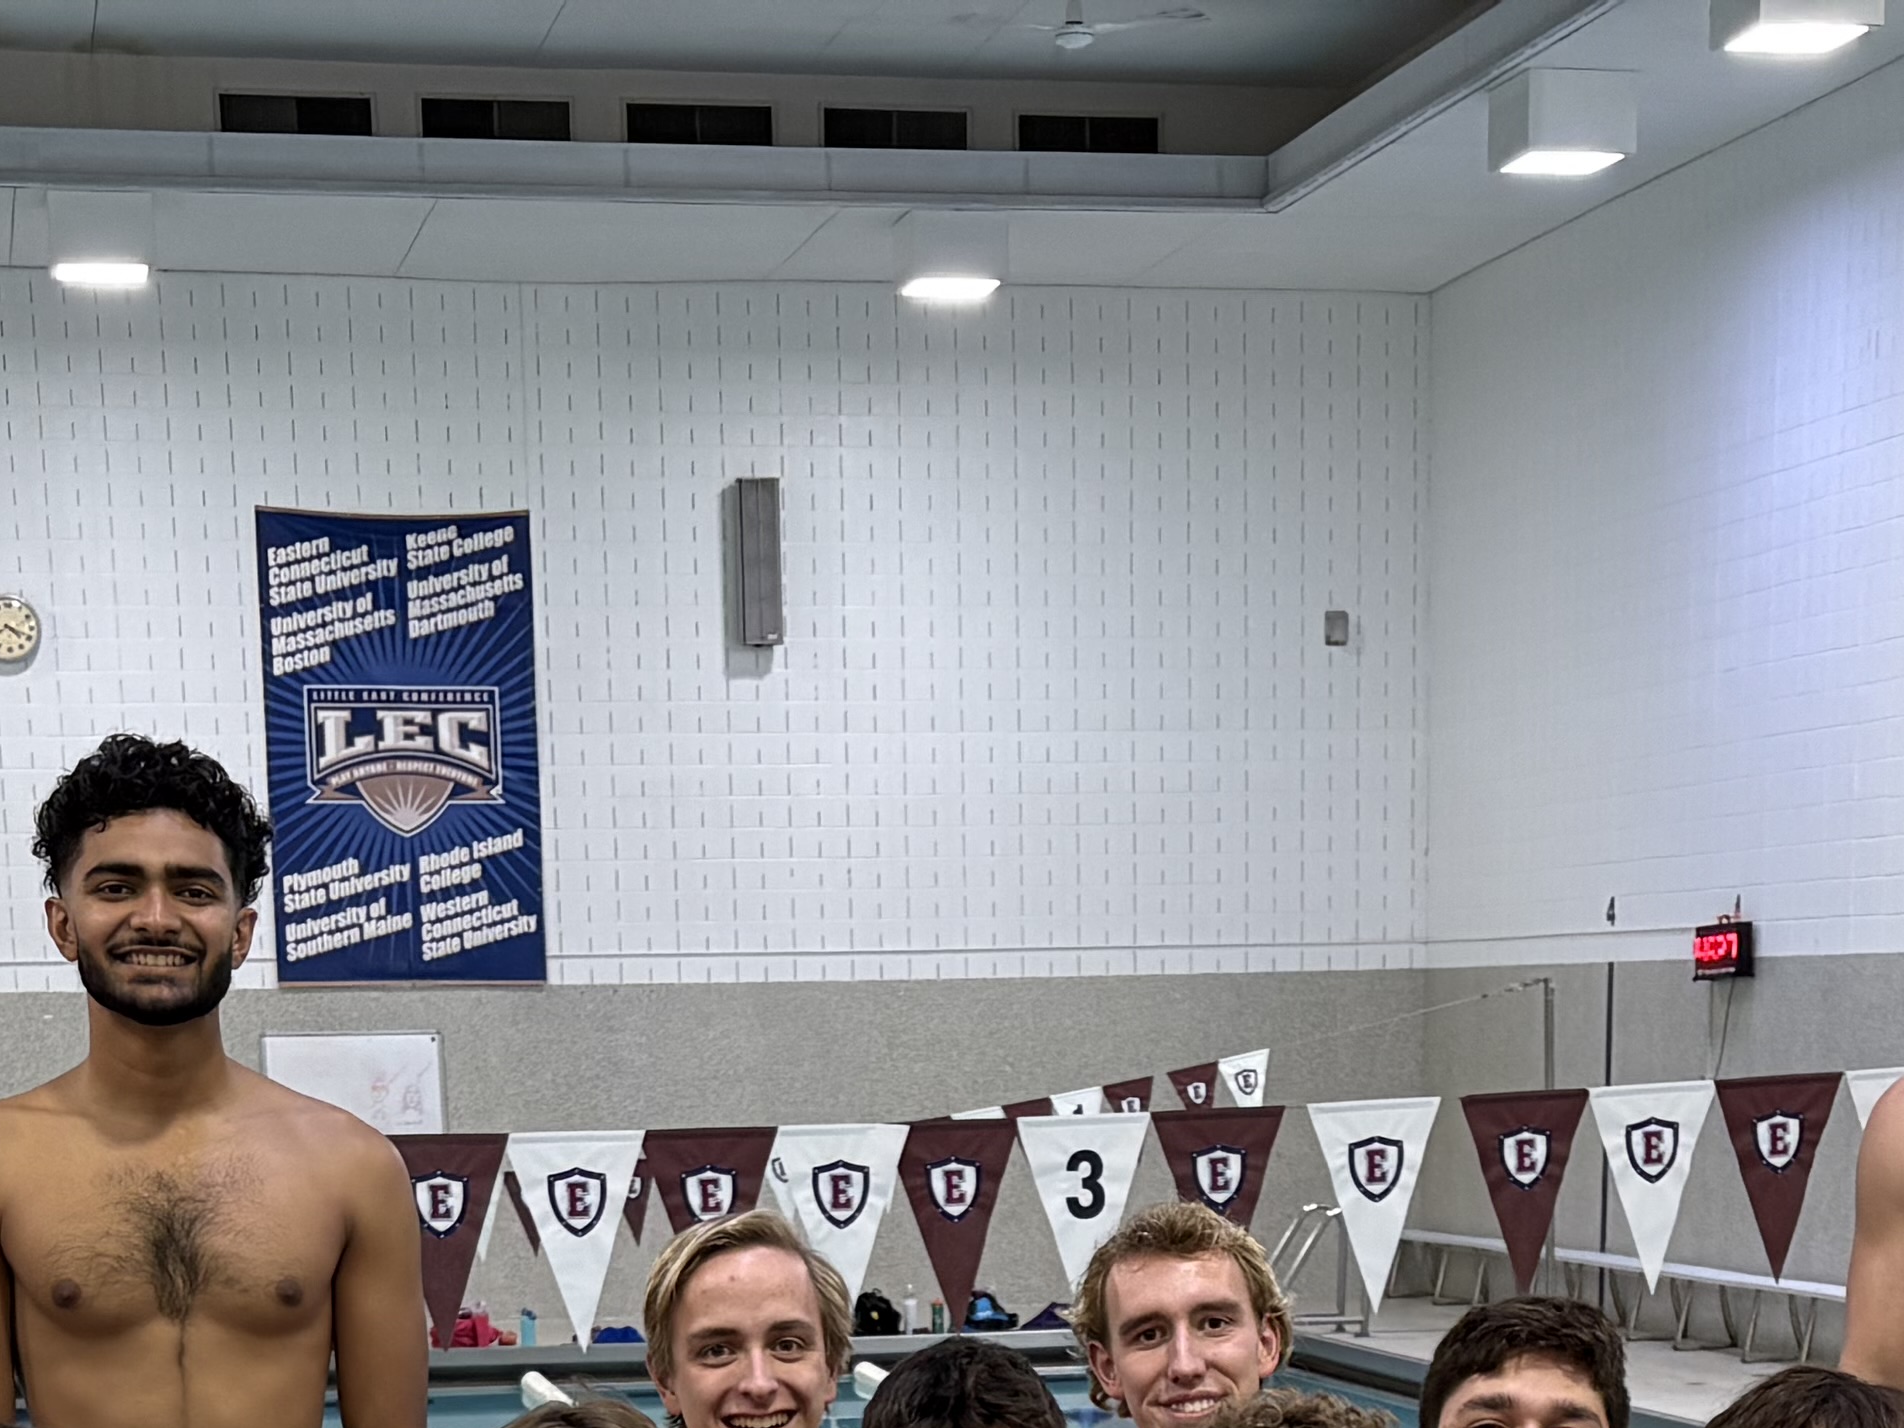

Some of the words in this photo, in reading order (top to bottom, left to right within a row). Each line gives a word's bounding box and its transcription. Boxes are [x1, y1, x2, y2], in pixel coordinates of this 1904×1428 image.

[268, 536, 330, 566] Eastern
[406, 525, 458, 550] Keene
[407, 544, 450, 570] State
[452, 525, 514, 558] College
[269, 544, 369, 585] Connecticut
[270, 578, 312, 607] State
[315, 557, 398, 600] University
[407, 563, 489, 599] University
[492, 554, 509, 576] of
[271, 600, 353, 636] University
[356, 592, 373, 613] of
[408, 573, 524, 619] Massachusetts
[272, 608, 396, 656] Massachusetts
[409, 600, 495, 639] Dartmouth
[273, 645, 331, 677] Boston
[317, 709, 489, 771] LEC
[419, 845, 469, 875] Rhode
[472, 828, 524, 859] Island
[283, 857, 360, 894] Plymouth
[284, 888, 326, 914] State
[329, 863, 411, 905] University
[420, 863, 482, 893] College
[286, 905, 367, 943] University
[370, 897, 386, 918] of
[420, 890, 489, 922] Western
[422, 899, 519, 941] Connecticut
[287, 926, 360, 962] Southern
[363, 912, 413, 940] Maine
[422, 934, 461, 961] State
[463, 914, 537, 949] University
[1516, 1138, 1539, 1174] E
[1642, 1130, 1665, 1165] E
[1769, 1122, 1790, 1157] E
[1065, 1149, 1105, 1219] 3
[1210, 1157, 1233, 1193] E
[1365, 1148, 1389, 1184] E
[429, 1184, 453, 1219] E
[566, 1183, 591, 1219] E
[699, 1179, 723, 1213] E
[830, 1173, 855, 1209] E
[943, 1170, 967, 1204] E
